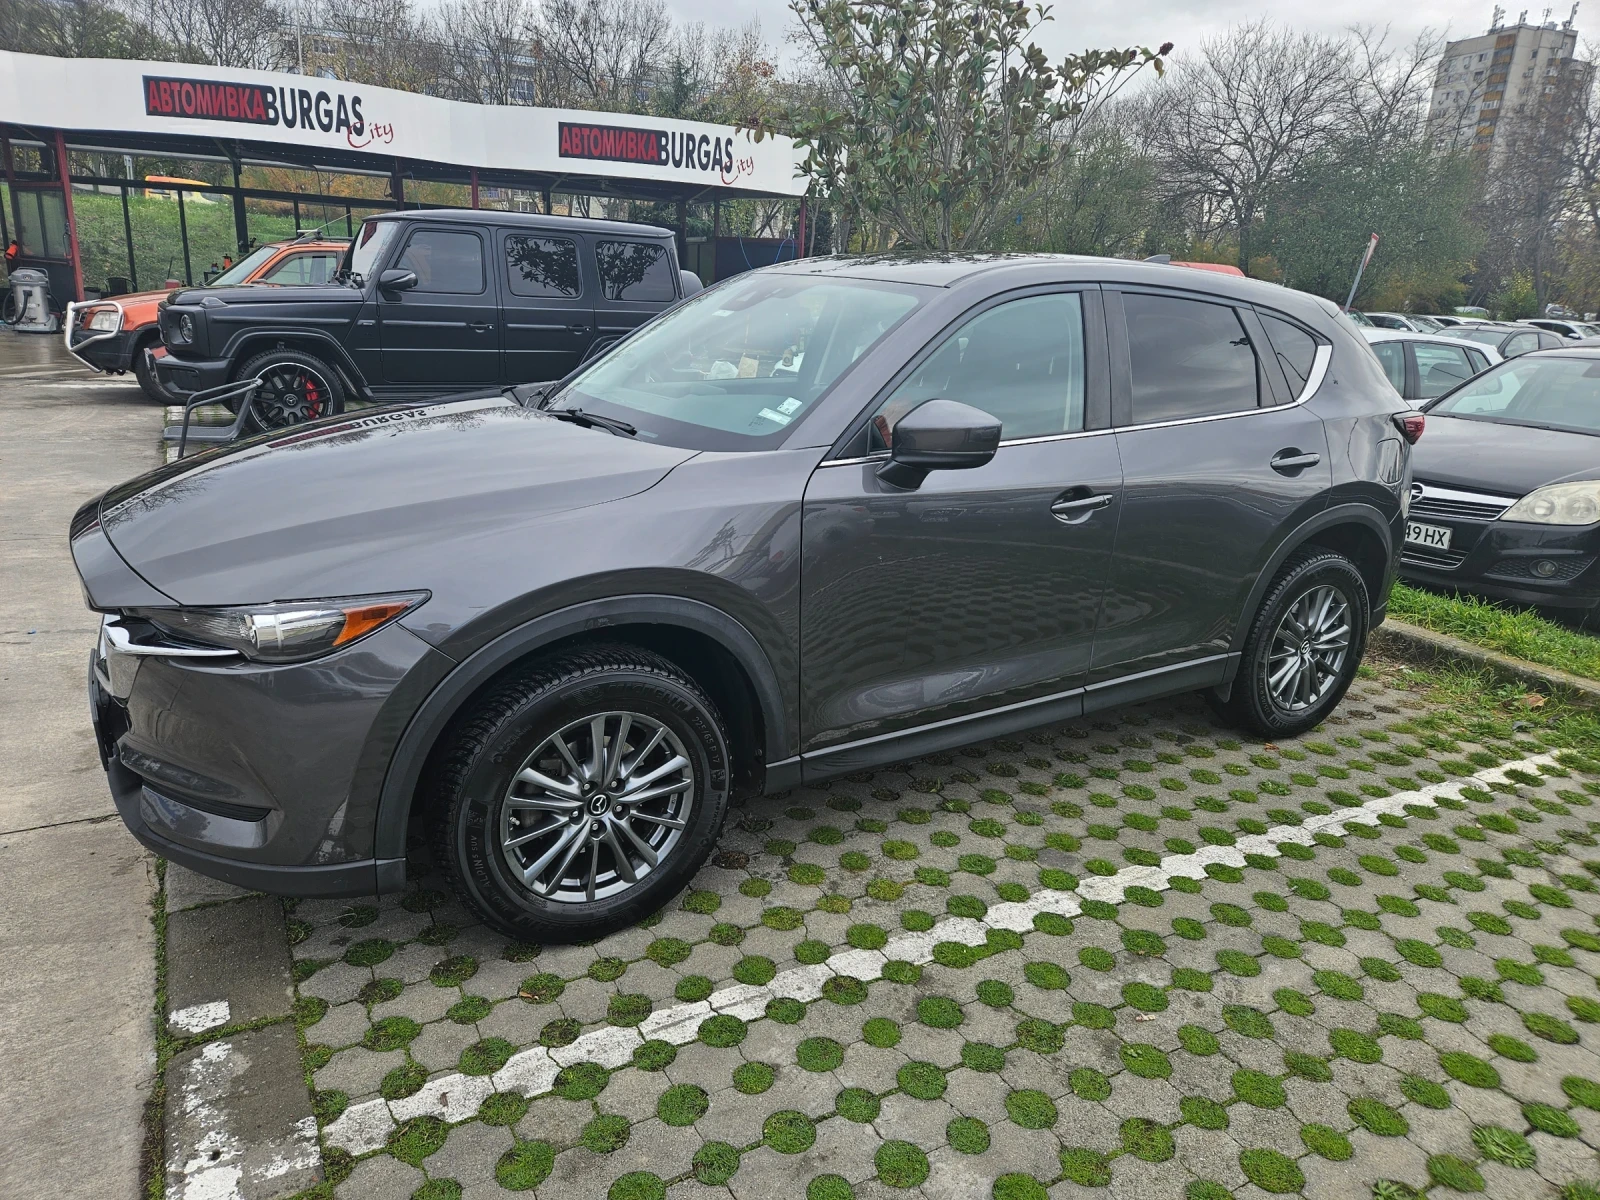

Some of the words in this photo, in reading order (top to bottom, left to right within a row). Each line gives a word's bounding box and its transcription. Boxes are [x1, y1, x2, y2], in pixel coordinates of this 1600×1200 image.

[149, 80, 267, 121] АВТОМИВКА
[265, 85, 365, 137] BURGAS
[560, 126, 659, 162] АВТОМИВКА
[659, 130, 734, 174] BURGAS
[1423, 527, 1447, 547] HX
[691, 716, 715, 744] 225/65
[712, 756, 720, 765] 17
[470, 834, 478, 851] SUV
[473, 858, 492, 889] ALPIN
